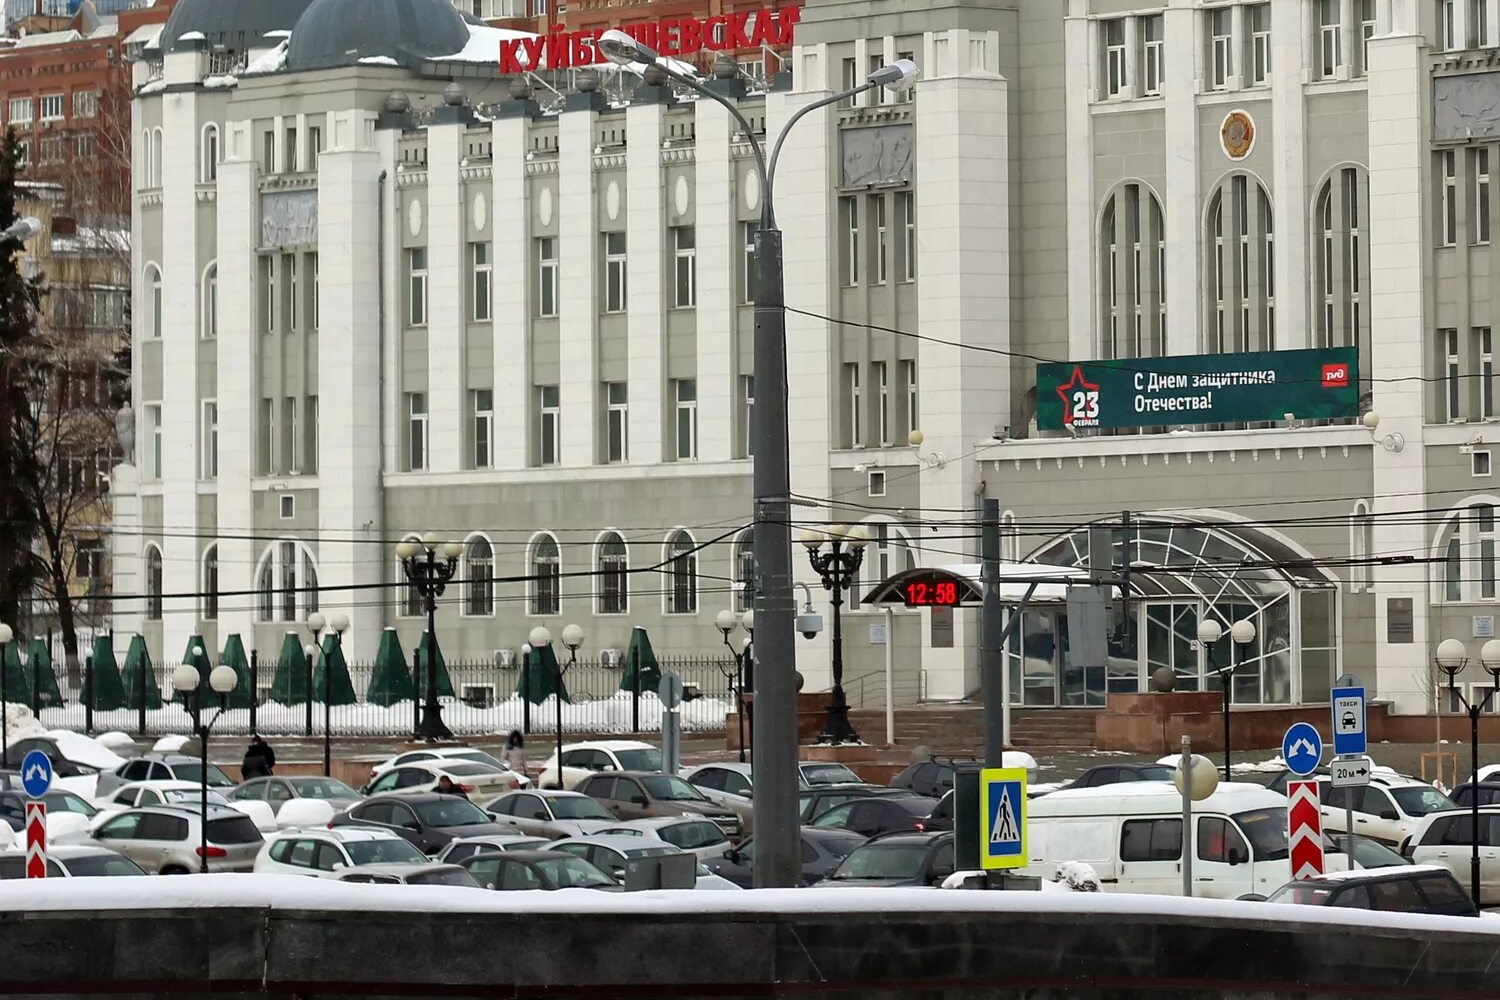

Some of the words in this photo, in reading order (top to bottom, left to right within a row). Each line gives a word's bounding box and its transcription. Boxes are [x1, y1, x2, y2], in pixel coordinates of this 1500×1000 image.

[1134, 372, 1144, 390] С
[1147, 372, 1188, 392] Днем
[1192, 370, 1276, 389] защитника
[1073, 391, 1099, 418] 23
[1134, 391, 1213, 412] Отечества!
[907, 583, 956, 604] 12:58
[1337, 768, 1347, 778] 20
